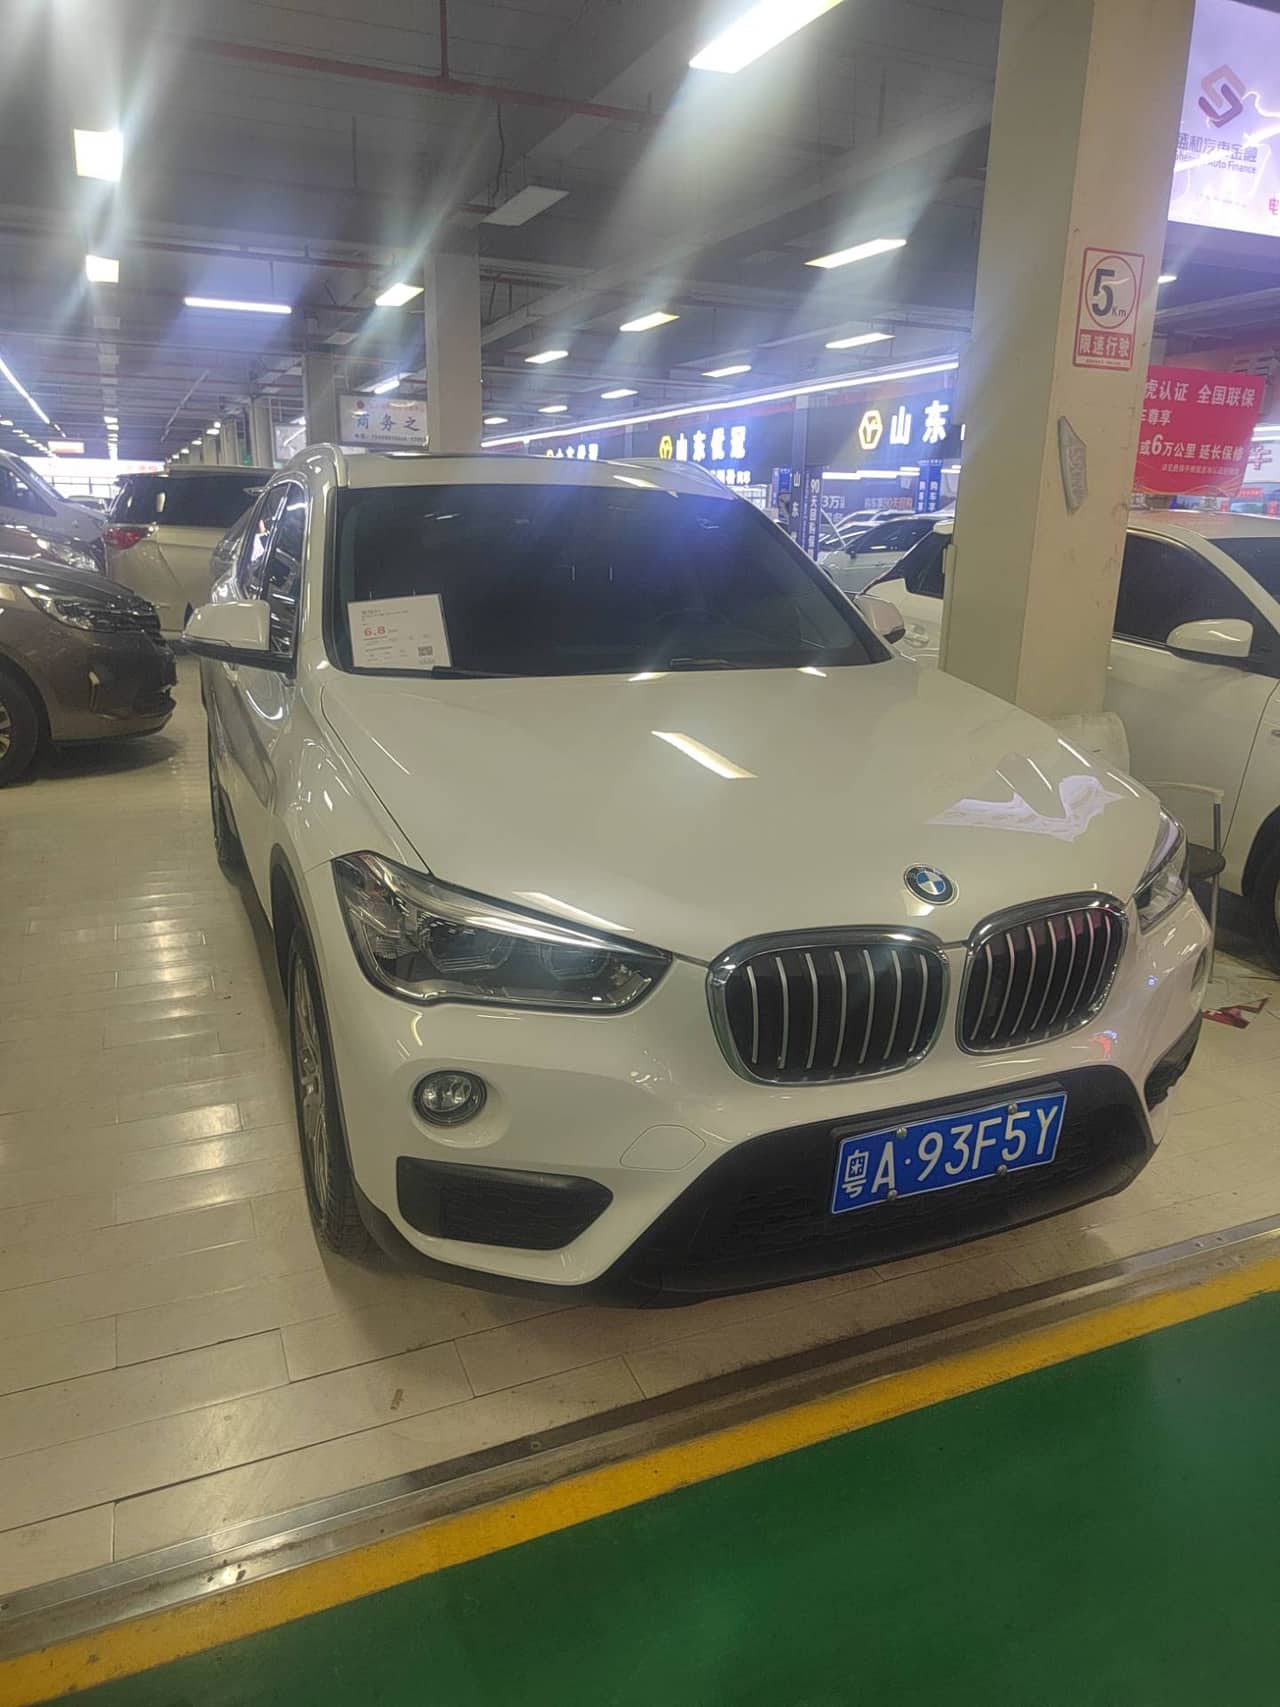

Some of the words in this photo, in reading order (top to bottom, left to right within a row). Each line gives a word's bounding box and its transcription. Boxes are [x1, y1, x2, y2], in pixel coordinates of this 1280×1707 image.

[1092, 268, 1115, 317] 5
[1079, 333, 1131, 357] 限速行驶
[1144, 378, 1189, 401] 虎认证
[1196, 383, 1257, 409] 全国联保
[1138, 434, 1196, 459] 或6万公里
[364, 625, 386, 637] 6.8
[842, 1105, 1059, 1199] 粤A·93F5Y
